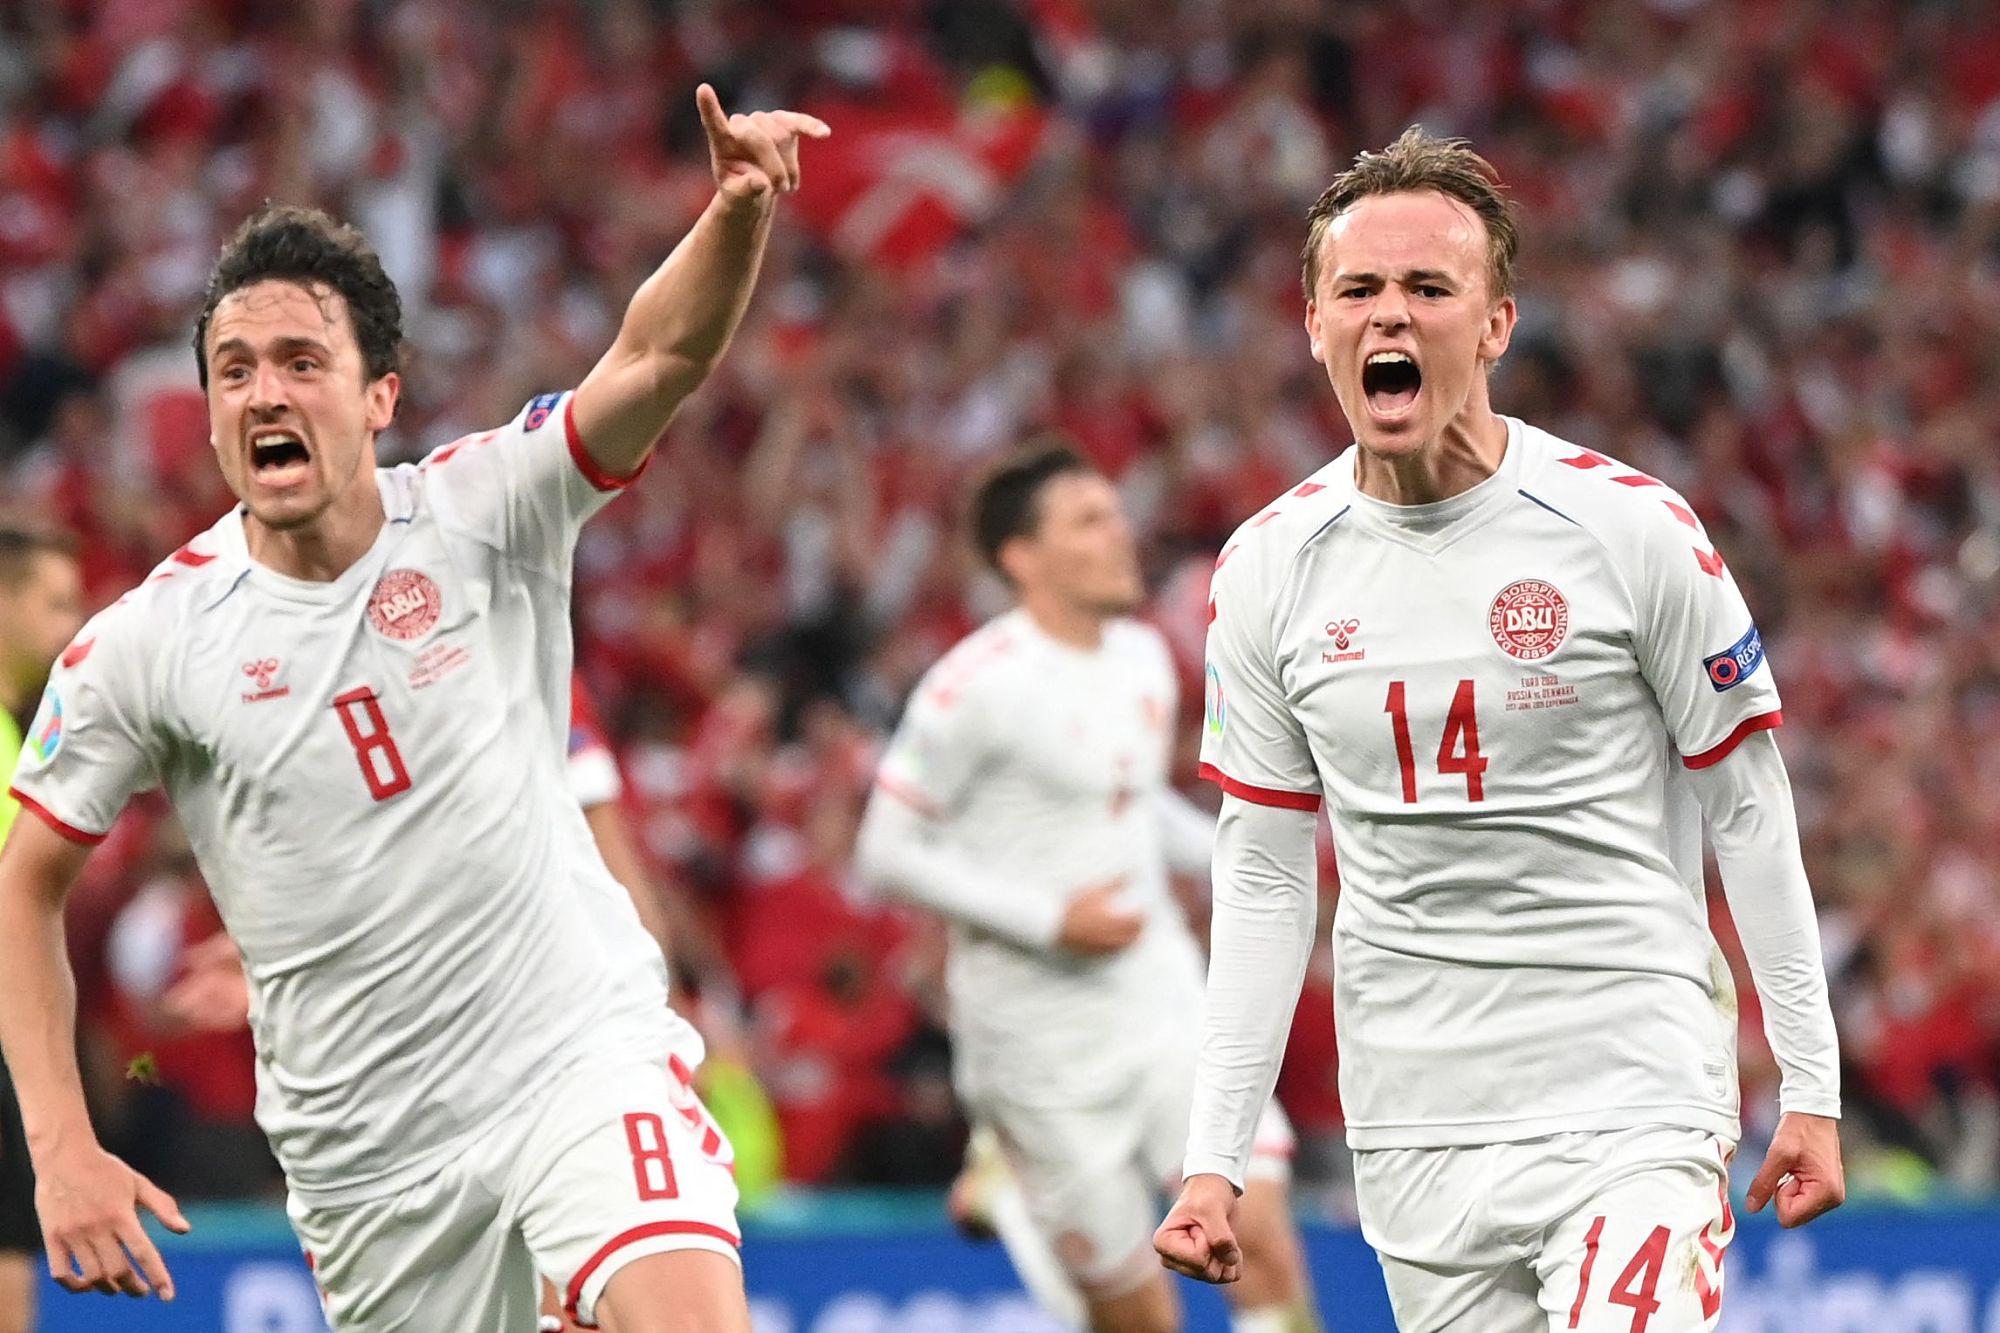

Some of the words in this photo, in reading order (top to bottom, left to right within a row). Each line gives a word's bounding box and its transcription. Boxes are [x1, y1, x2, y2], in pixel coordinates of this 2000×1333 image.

[380, 586, 427, 622] DBU
[1505, 607, 1554, 631] DBU
[1552, 603, 1567, 647] UNION
[1491, 605, 1513, 652] DANSK
[1322, 648, 1365, 664] hummel
[1515, 647, 1549, 659] 1889
[1507, 690, 1532, 701] RUSSIA
[1542, 686, 1575, 698] DENMARK
[333, 686, 412, 802] 8
[1384, 679, 1488, 803] 14
[623, 1112, 679, 1202] 8
[1568, 1216, 1671, 1333] 14
